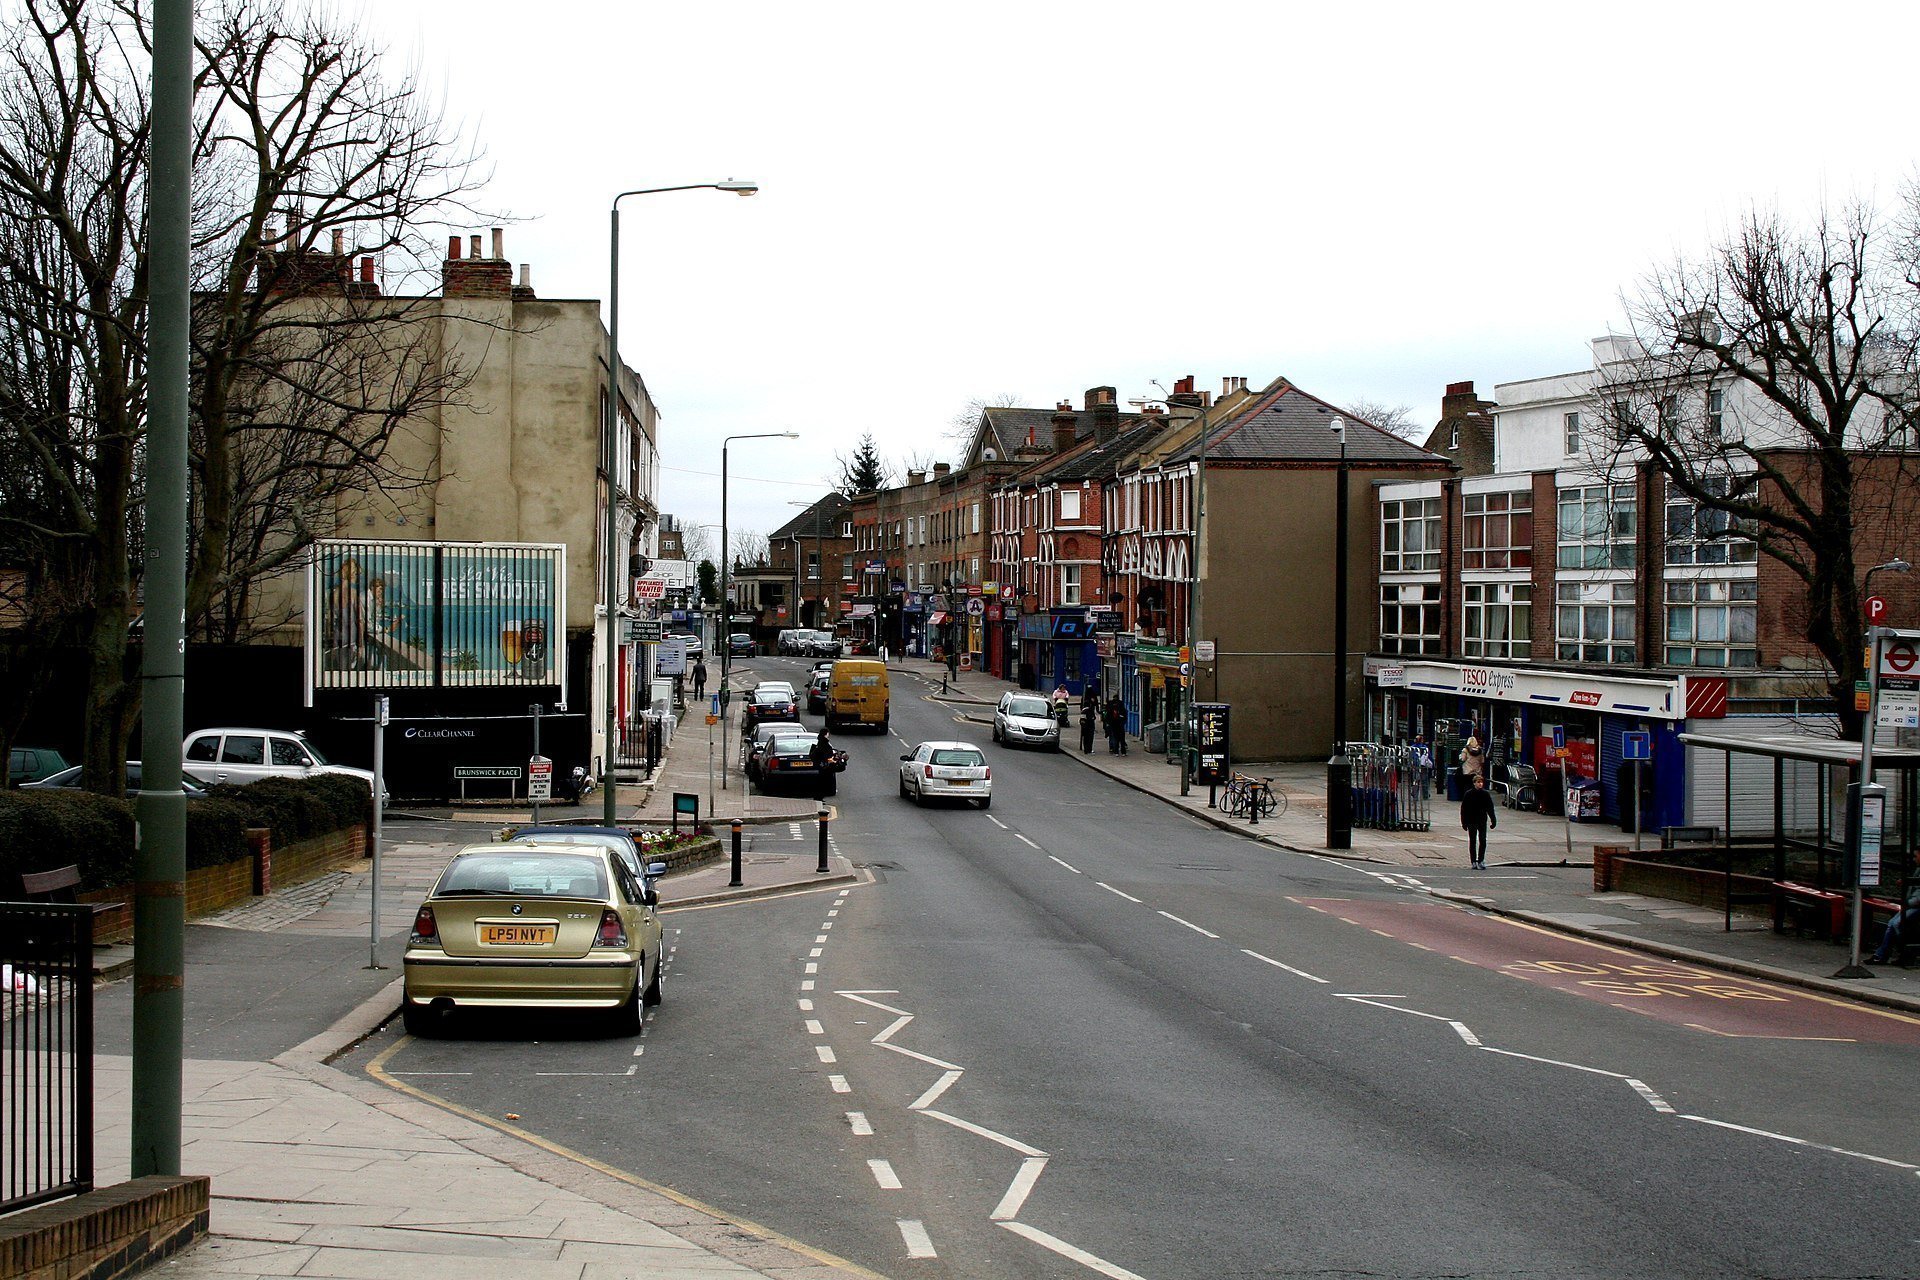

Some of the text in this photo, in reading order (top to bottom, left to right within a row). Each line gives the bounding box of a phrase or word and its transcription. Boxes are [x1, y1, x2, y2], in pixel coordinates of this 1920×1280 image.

[475, 582, 546, 600] SMOOTH
[665, 578, 684, 587] ET
[1871, 600, 1883, 617] P
[1462, 669, 1487, 686] TESCO
[488, 928, 547, 941] LP51 NVT
[1576, 979, 1792, 1003] BUS
